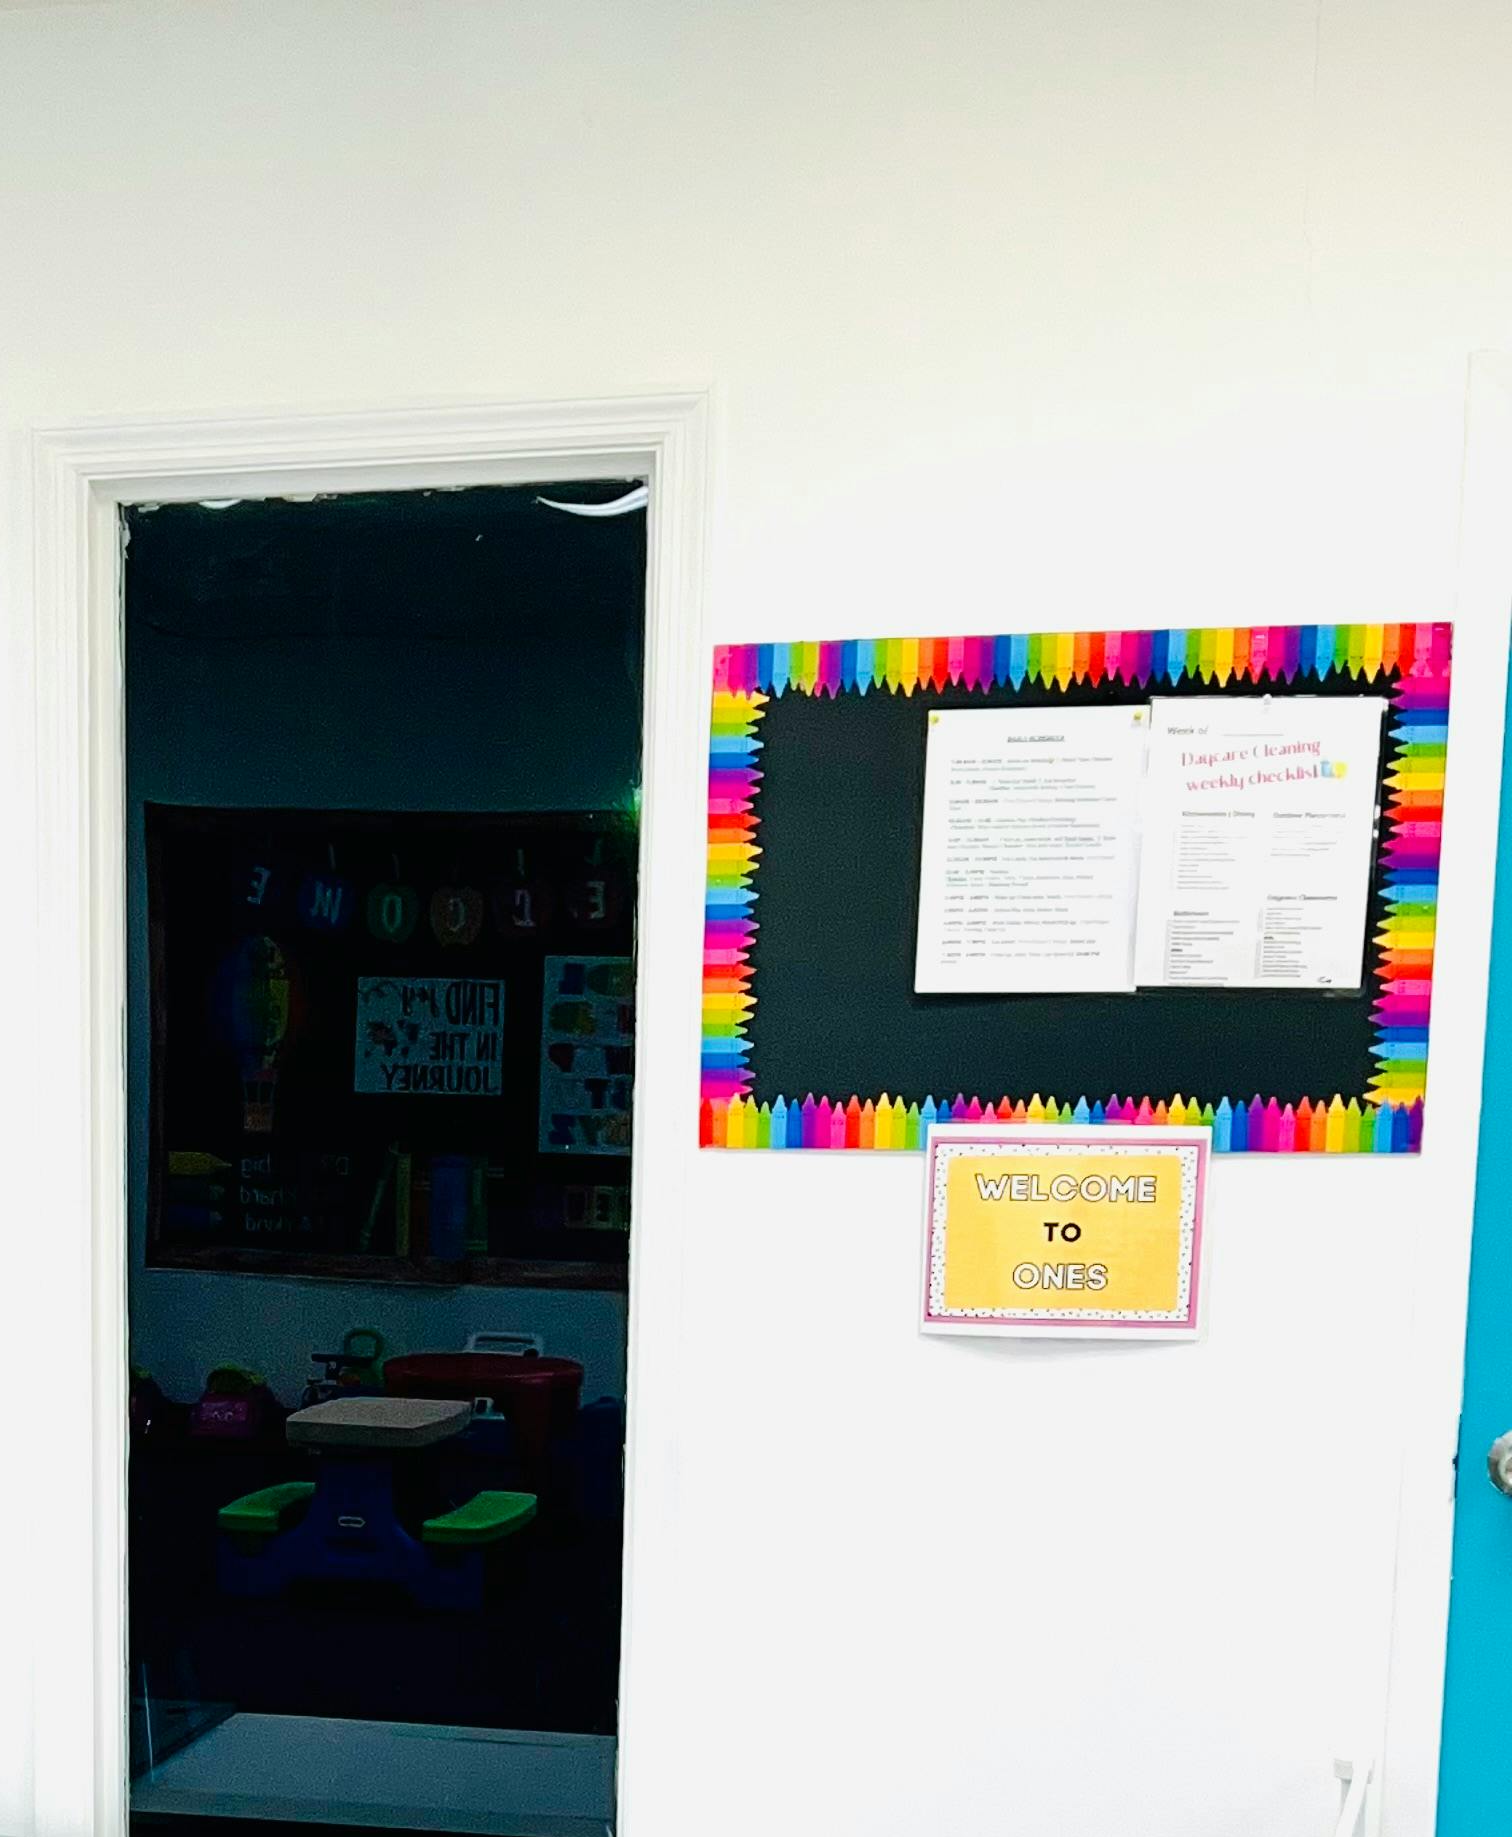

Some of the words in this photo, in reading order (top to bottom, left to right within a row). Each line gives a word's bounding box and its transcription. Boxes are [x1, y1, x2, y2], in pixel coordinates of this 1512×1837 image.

[1182, 749, 1248, 767] Daycare
[1253, 741, 1320, 757] Cleaning
[1187, 774, 1244, 791] weekly
[1248, 765, 1318, 785] checklist
[974, 1173, 1157, 1203] WELCOME
[1043, 1222, 1082, 1242] TO
[1012, 1262, 1108, 1290] ONES
